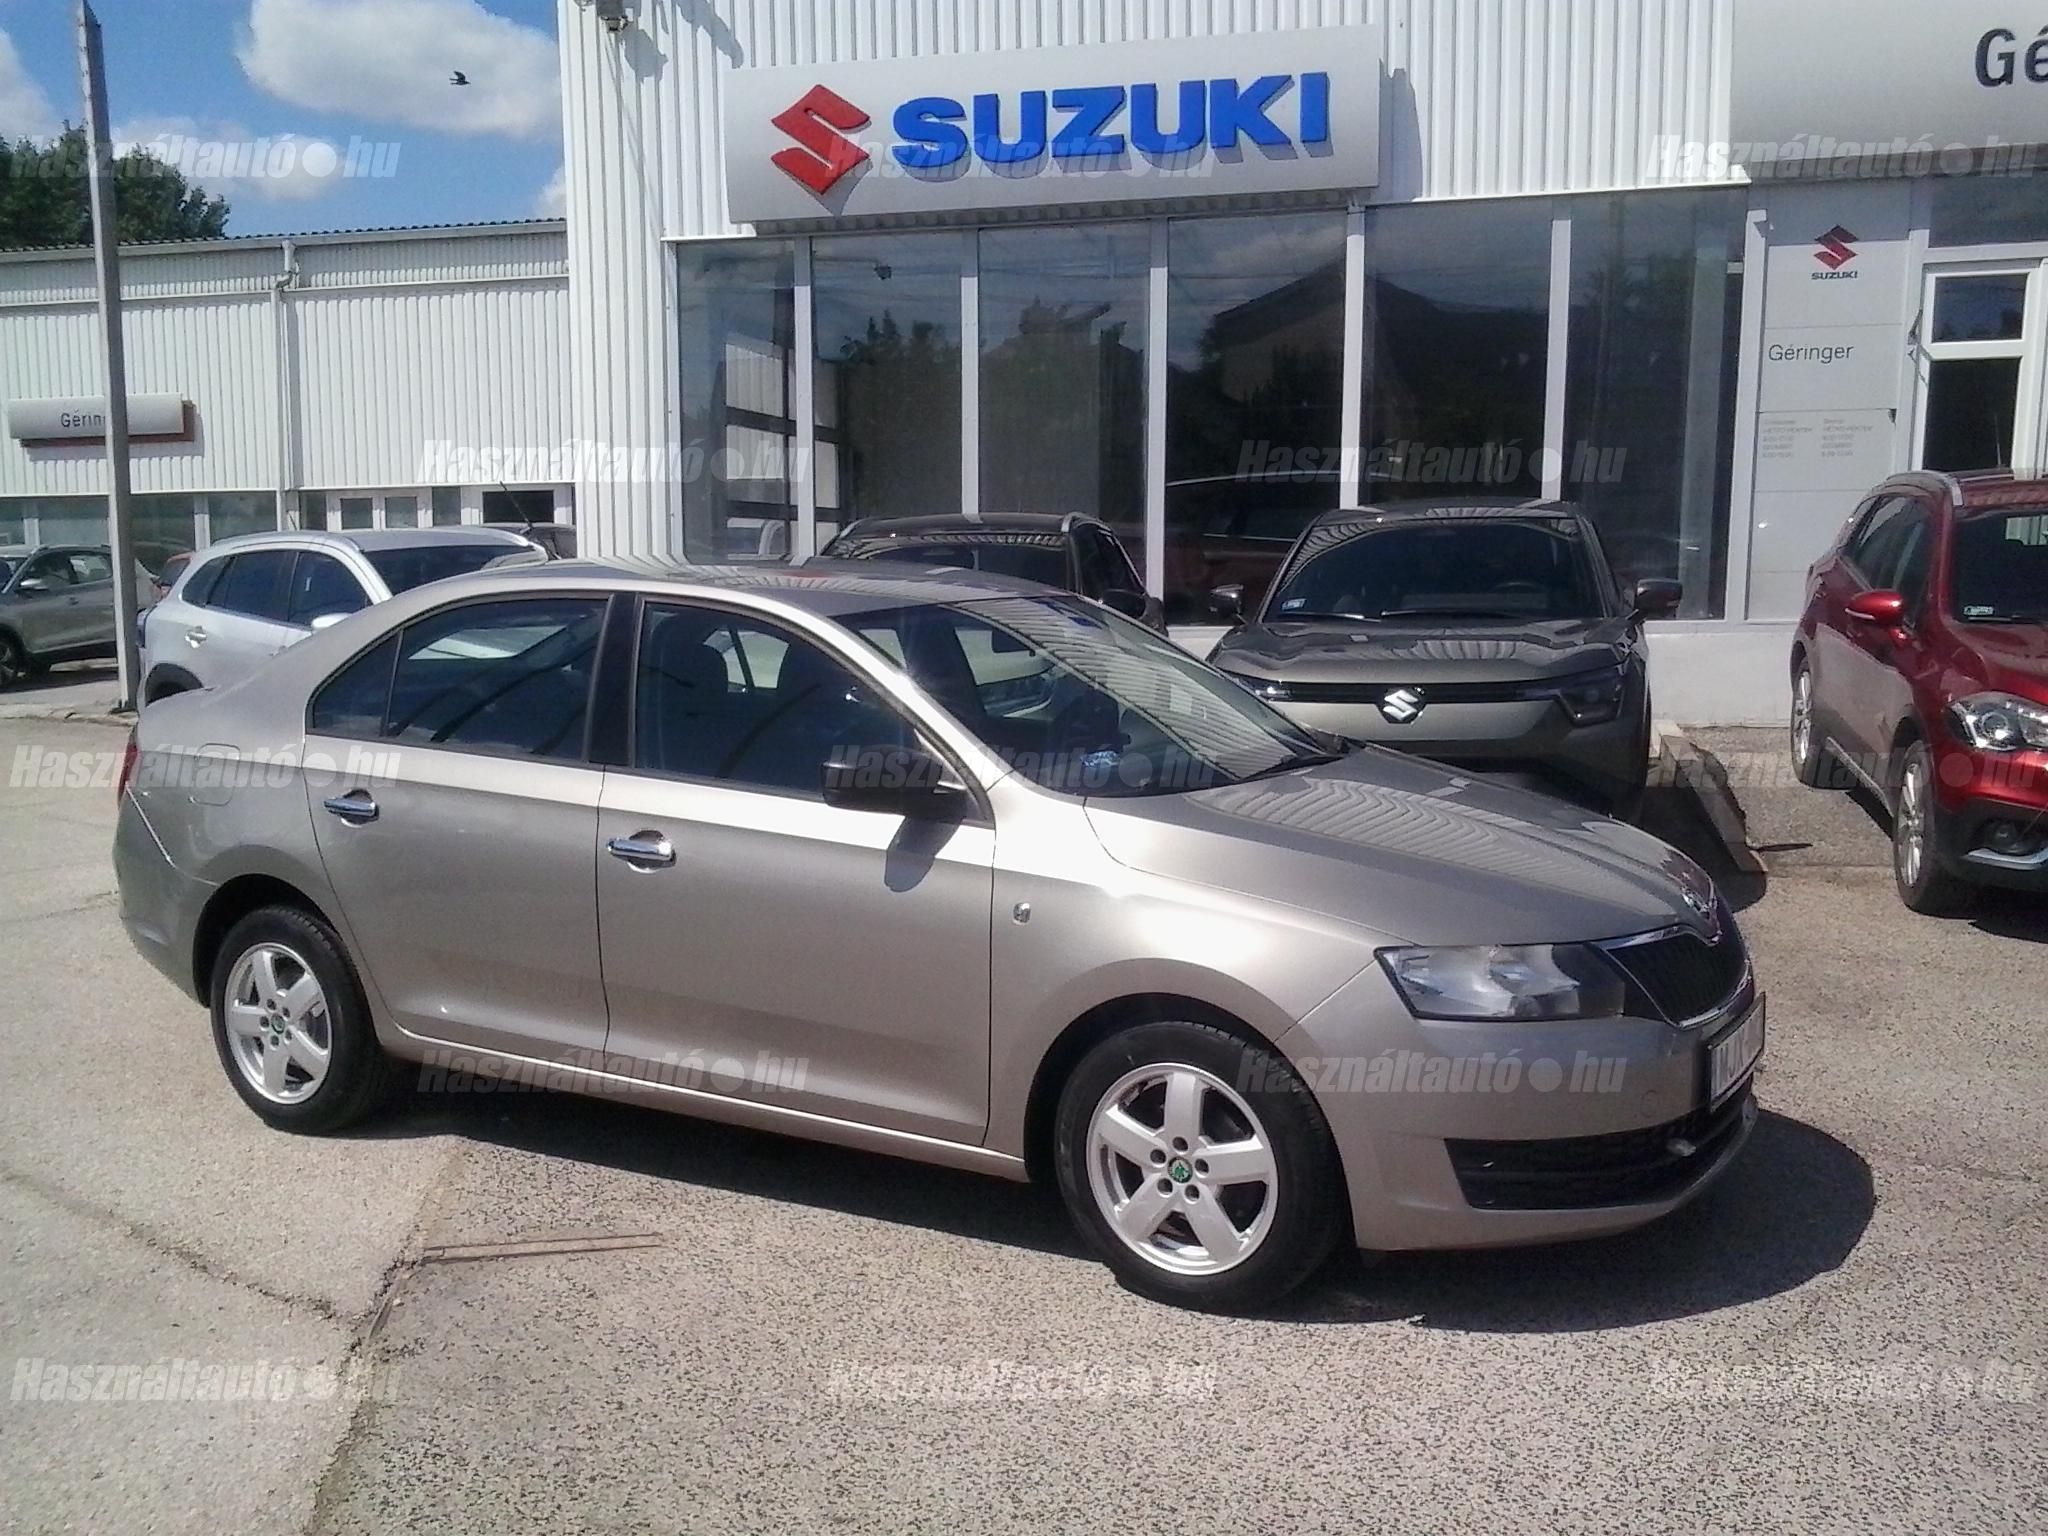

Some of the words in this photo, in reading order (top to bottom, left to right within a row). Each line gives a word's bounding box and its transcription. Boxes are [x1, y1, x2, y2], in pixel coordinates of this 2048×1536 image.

[893, 72, 1330, 170] SUZUKI
[1811, 271, 1859, 280] SUZUKI
[1768, 344, 1854, 364] Géringer
[60, 409, 107, 428] Gérin
